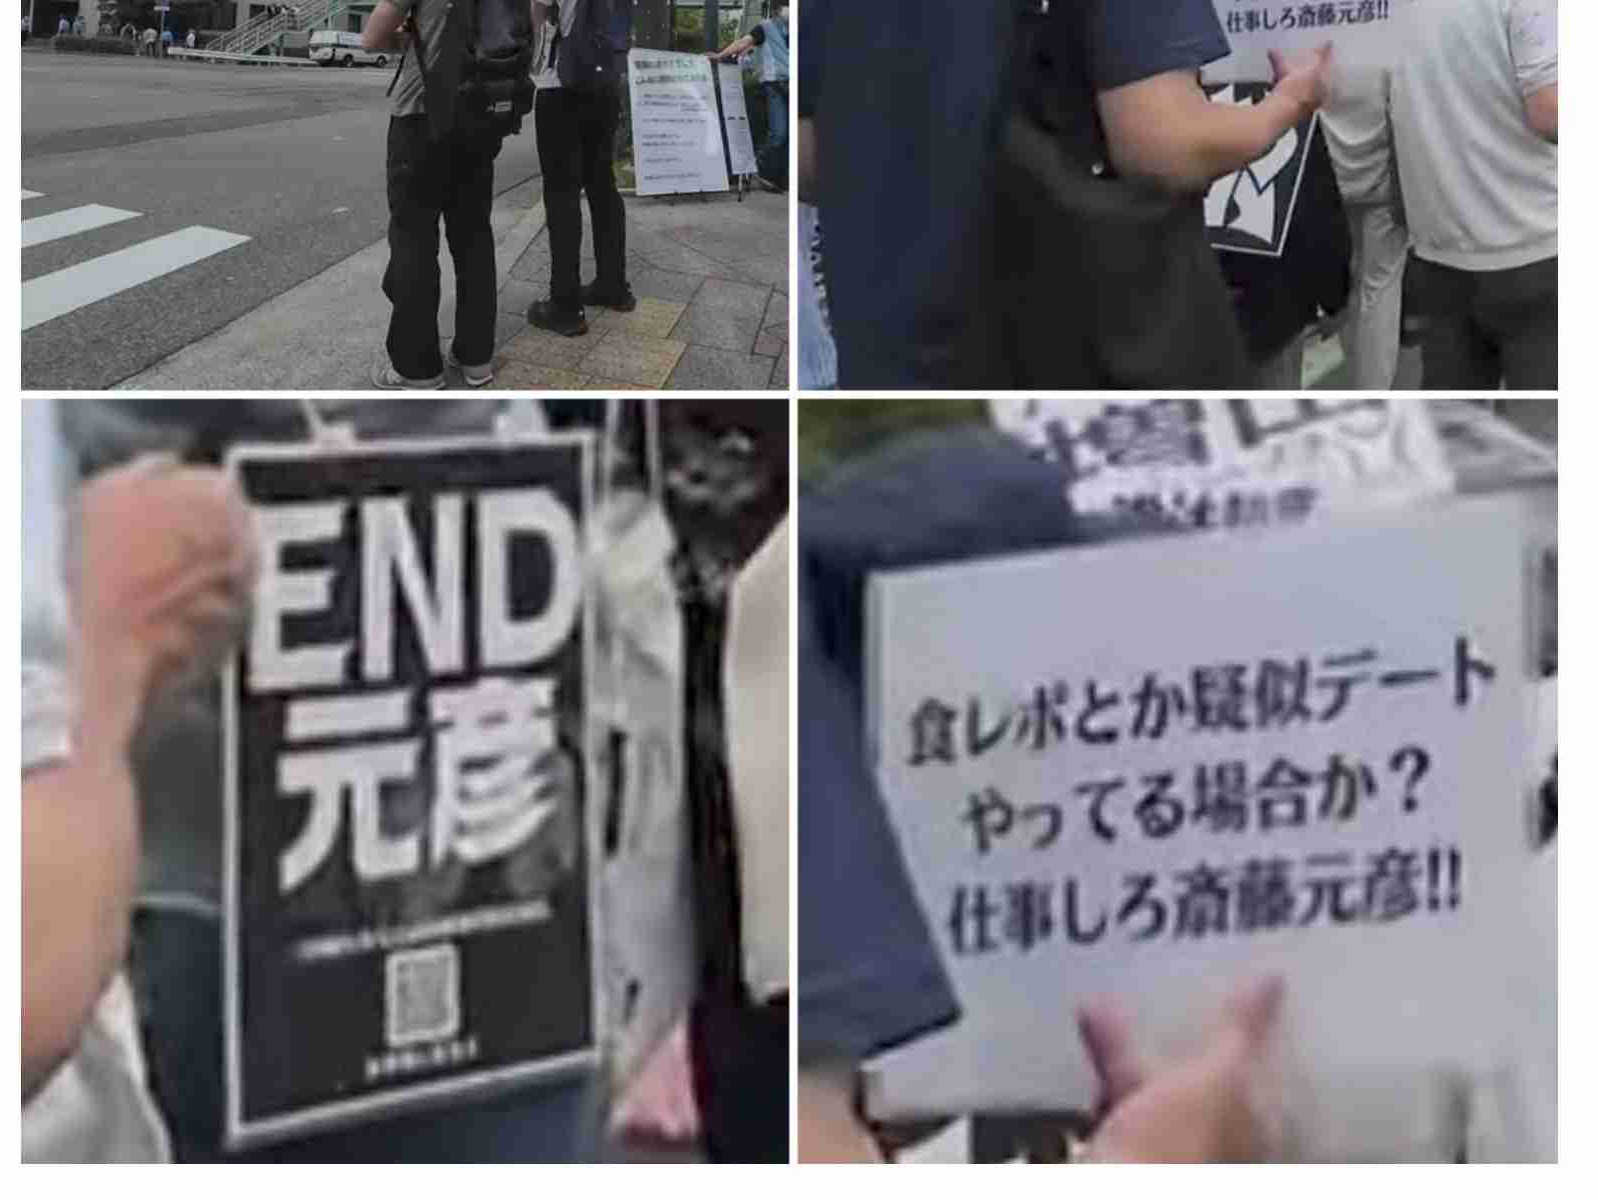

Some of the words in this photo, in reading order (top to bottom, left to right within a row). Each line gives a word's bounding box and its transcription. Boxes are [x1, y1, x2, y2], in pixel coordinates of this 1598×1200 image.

[247, 487, 583, 696] END
[276, 676, 559, 895] 元彦
[907, 635, 1497, 767] 食レポとか疑似デート
